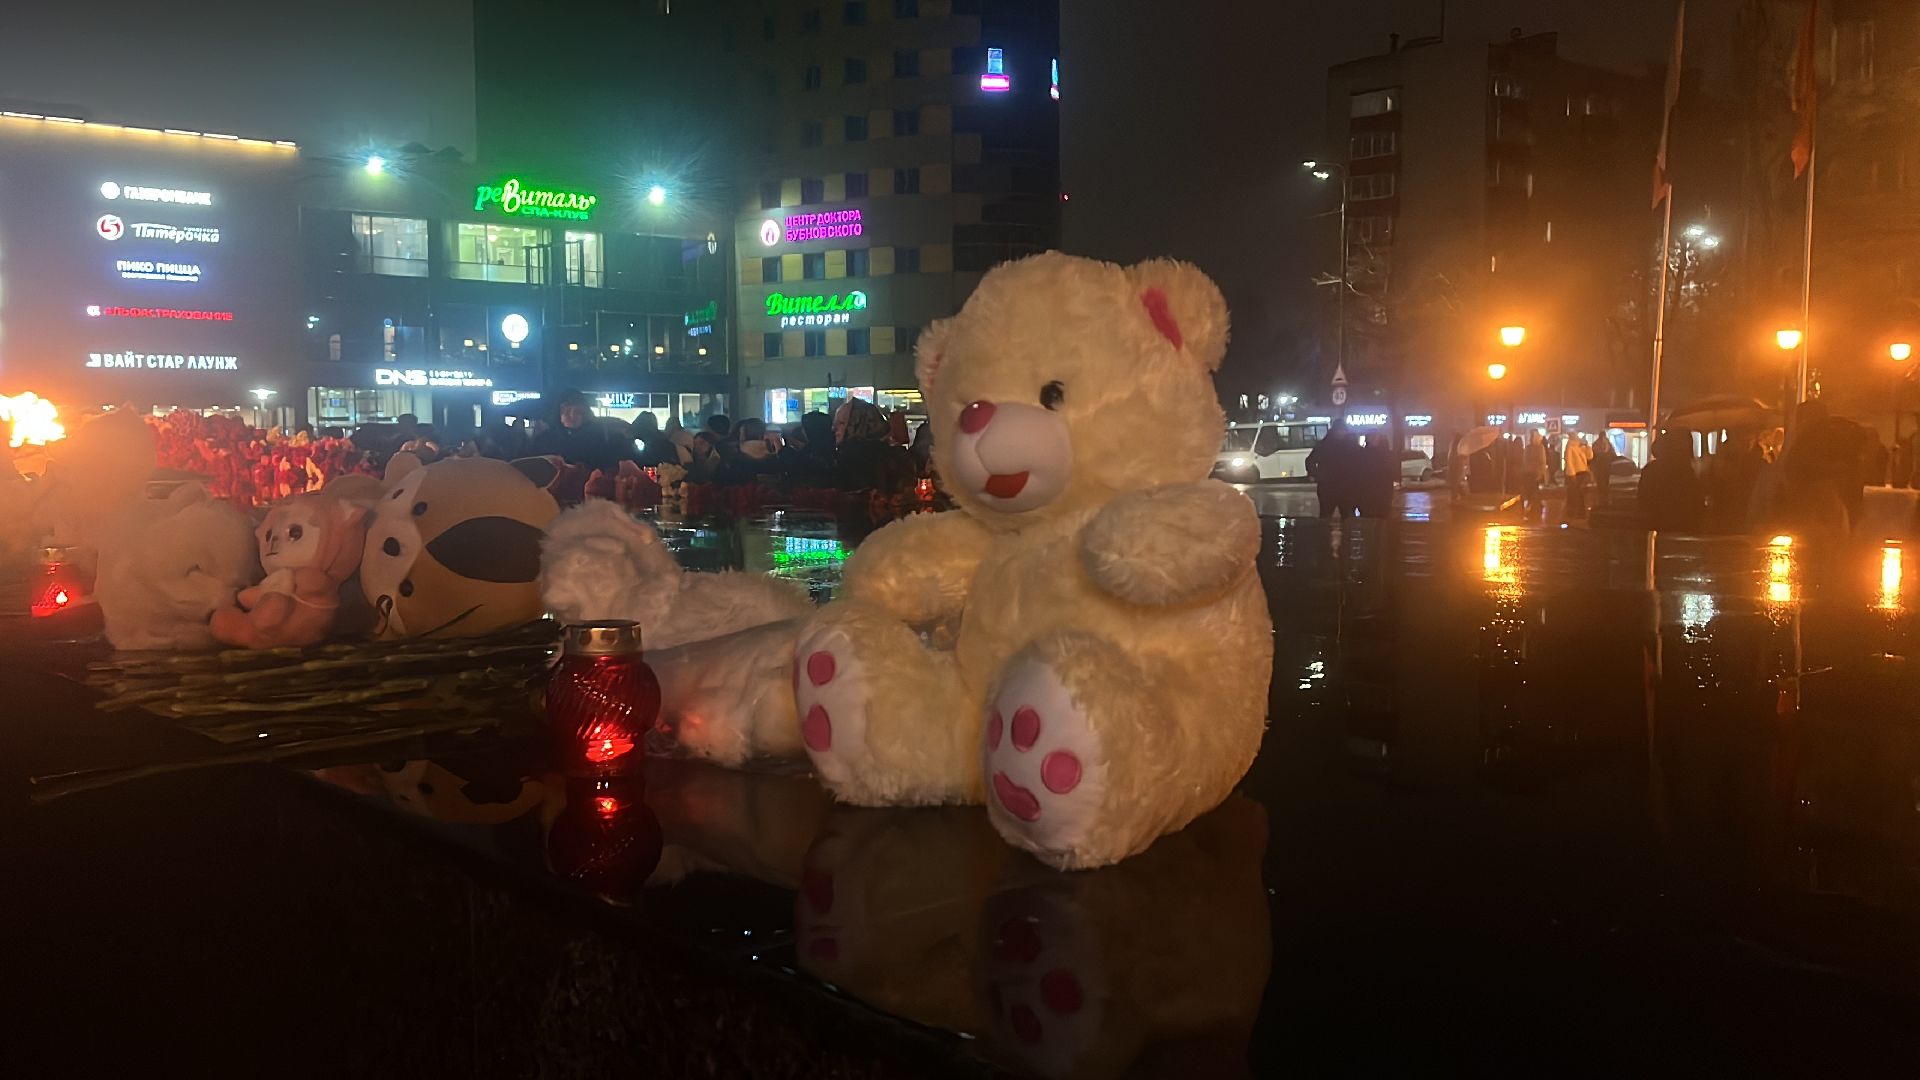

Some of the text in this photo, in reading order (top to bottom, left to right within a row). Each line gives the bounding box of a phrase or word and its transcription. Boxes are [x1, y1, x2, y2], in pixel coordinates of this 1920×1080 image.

[785, 210, 861, 228] ЦЕНТР ДОКТОРА
[786, 224, 862, 241] БУБНОВСКОГО
[116, 260, 201, 275] ПИКО ПИЦЦА
[781, 313, 849, 328] ресторан
[103, 352, 238, 370] ВАЙТ СТАР ЛАУНЖ
[375, 369, 428, 386] DNS
